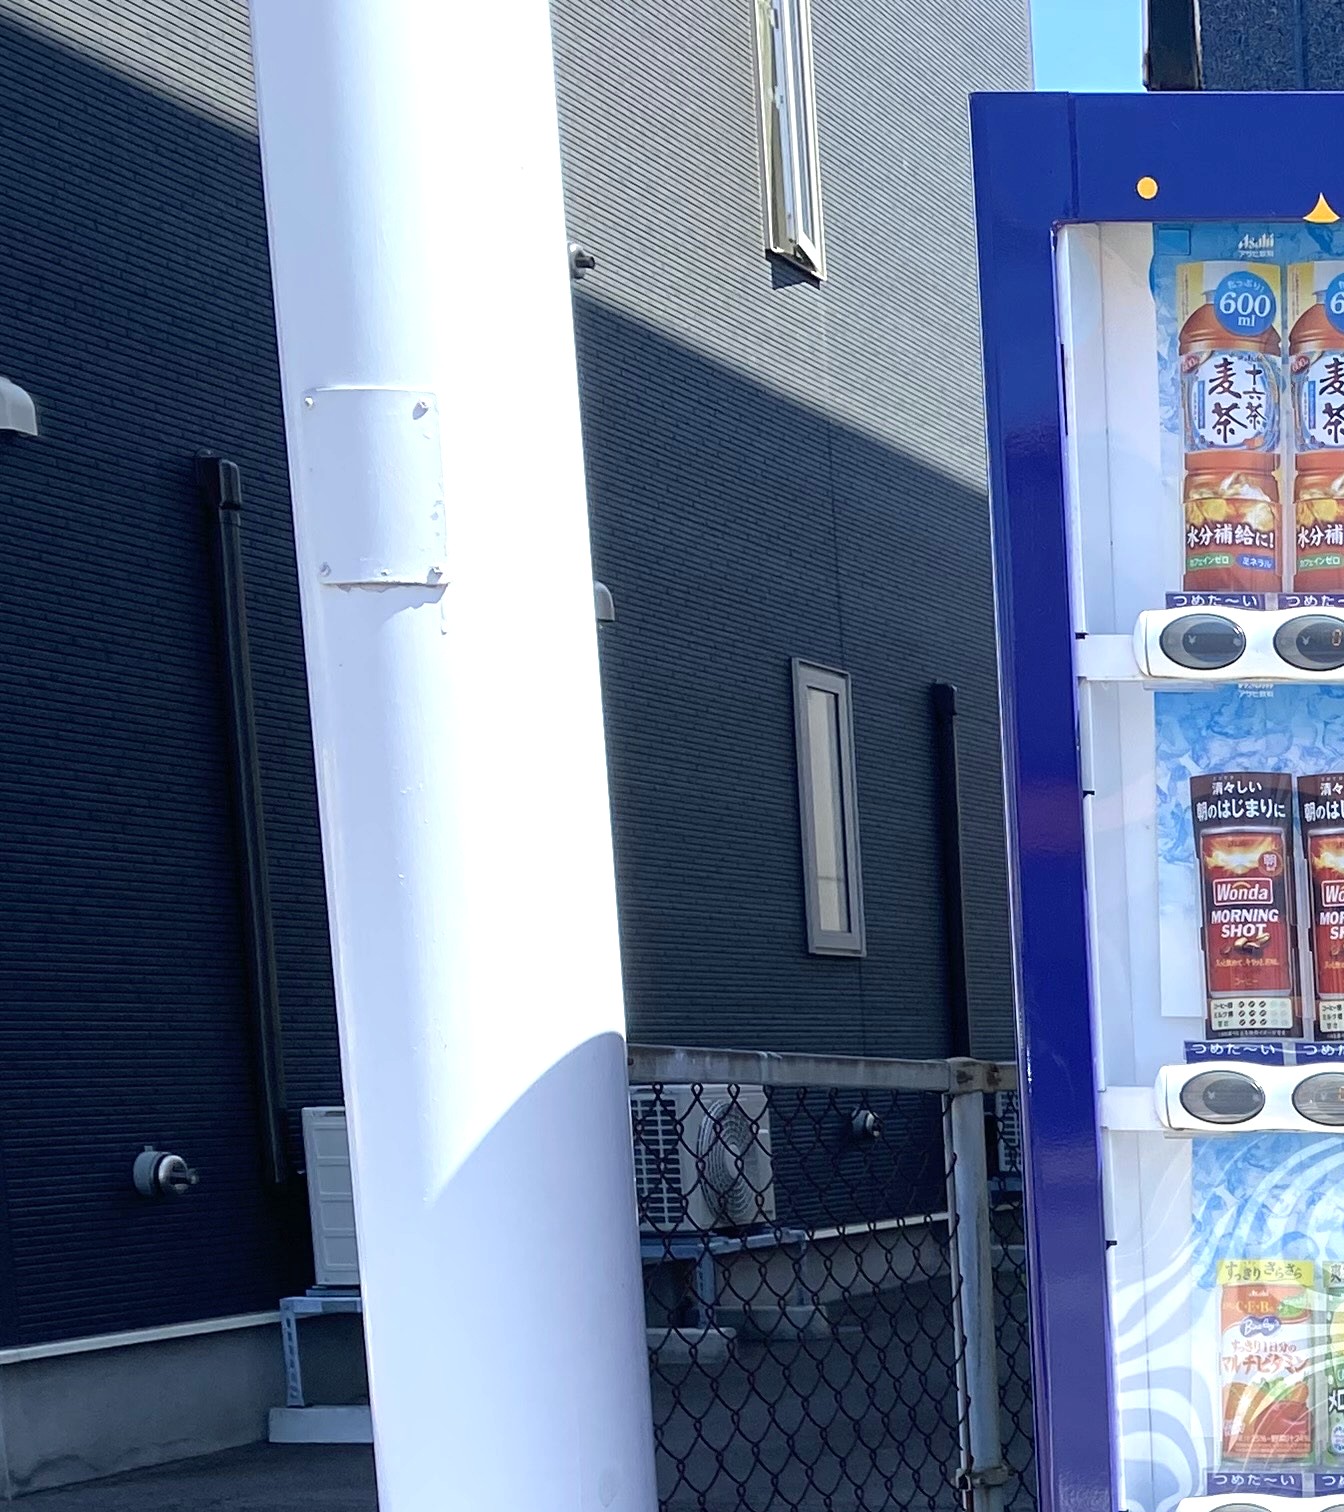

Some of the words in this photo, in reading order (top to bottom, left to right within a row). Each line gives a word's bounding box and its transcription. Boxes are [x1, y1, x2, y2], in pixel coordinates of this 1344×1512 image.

[1220, 292, 1271, 318] 600
[1238, 315, 1255, 327] ml
[1208, 358, 1247, 443] 麦茶
[1243, 364, 1267, 430] 十六茶
[1212, 781, 1262, 795] 清々しい
[1196, 799, 1286, 821] 朝のはじまりに
[1217, 884, 1268, 901] Wonda
[1211, 909, 1279, 924] MORNING
[1221, 924, 1267, 938] SHOT
